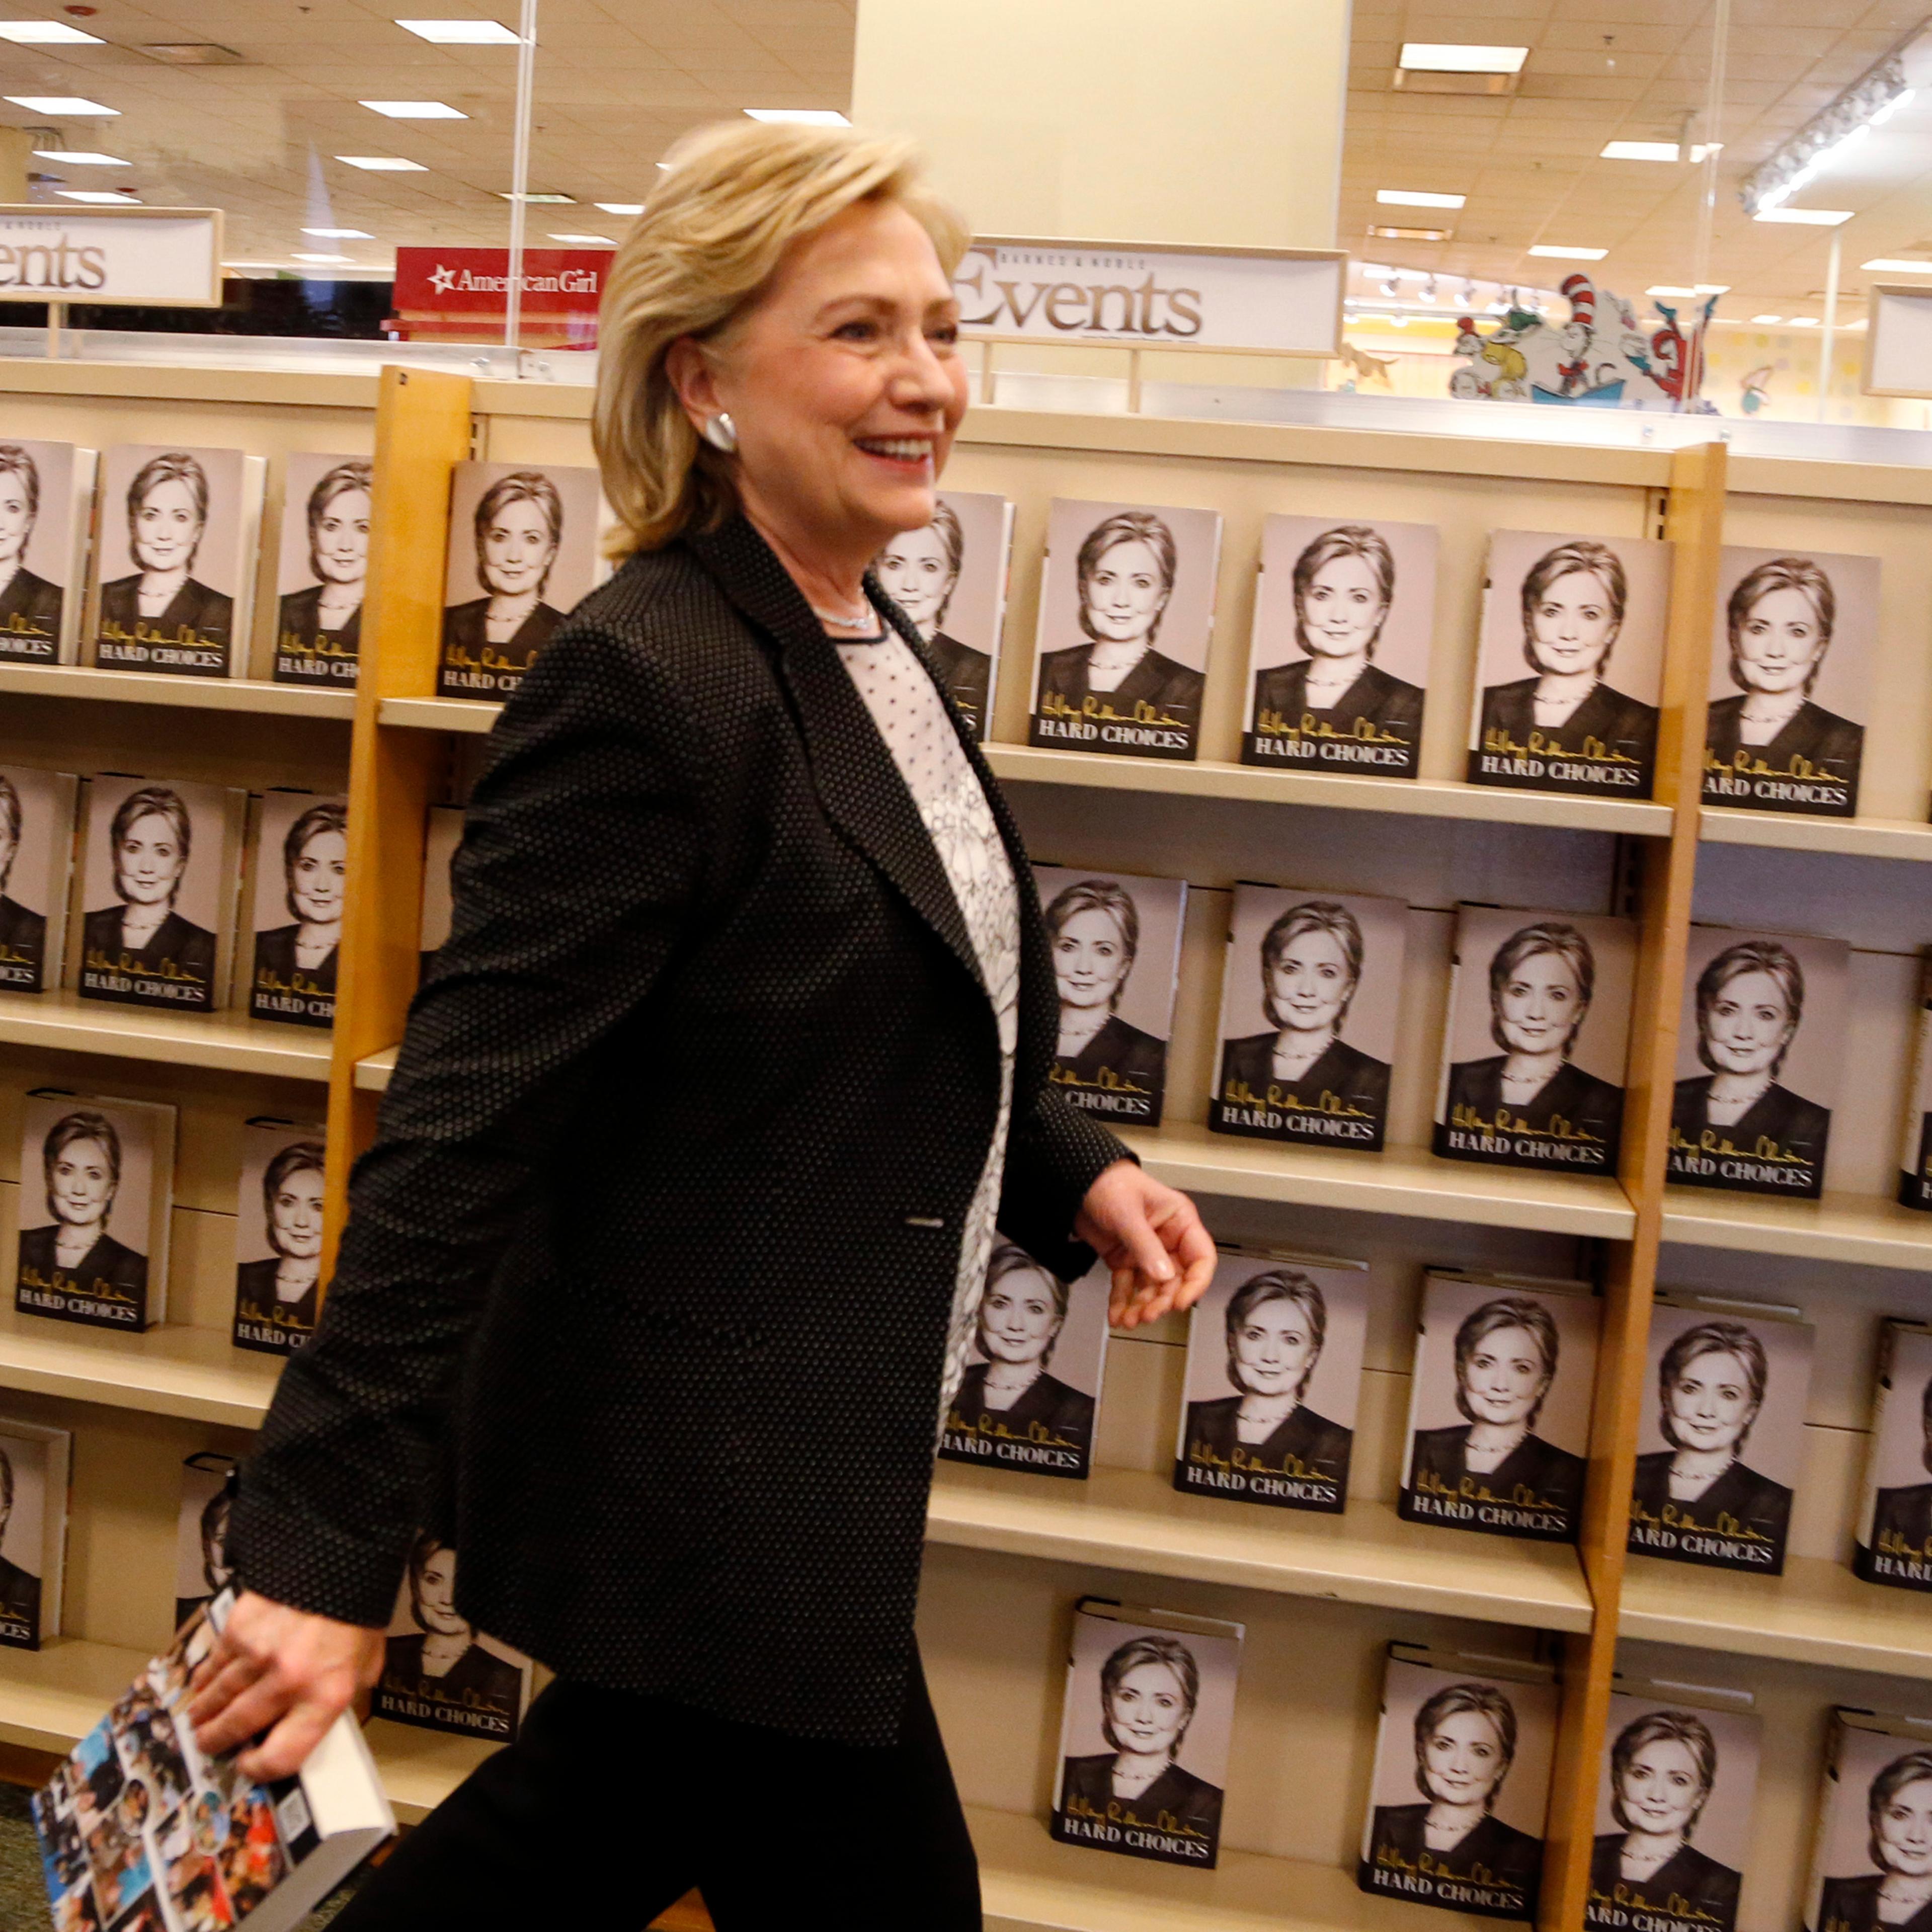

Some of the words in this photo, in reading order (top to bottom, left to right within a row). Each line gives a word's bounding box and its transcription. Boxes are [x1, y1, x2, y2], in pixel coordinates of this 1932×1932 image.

[100, 645, 149, 662] HARD
[278, 657, 329, 676] HARD
[444, 670, 495, 689] HARD
[1039, 719, 1098, 741] HARD
[1101, 725, 1189, 750] CHOICES
[1255, 737, 1317, 758] HARD
[1320, 742, 1410, 767] CHOICES
[1481, 756, 1545, 777] HARD
[1548, 762, 1641, 786] CHOICES
[1702, 776, 1751, 796] ARD
[1754, 780, 1848, 806] CHOICES
[1064, 1090, 1151, 1115] CHOICES
[1222, 1106, 1282, 1129] HARD
[1285, 1115, 1375, 1141] CHOICES
[1448, 1131, 1511, 1154] HARD
[1514, 1139, 1605, 1165] CHOICES
[1666, 1155, 1717, 1176] ARD
[1720, 1161, 1813, 1188] CHOICES
[996, 1442, 1081, 1470] CHOICES
[1187, 1466, 1246, 1490] HARD
[1250, 1477, 1337, 1503] CHOICES
[1413, 1495, 1475, 1520] HARD
[1478, 1505, 1567, 1533] CHOICES
[1631, 1526, 1677, 1549] ARD
[1681, 1535, 1773, 1564] CHOICES
[381, 1694, 431, 1718] HARD
[1064, 1818, 1121, 1842] HARD
[1124, 1830, 1210, 1859] CHOICES
[1373, 1868, 1433, 1895] HARD
[1436, 1882, 1524, 1910] CHOICES
[1586, 1905, 1628, 1926] ARD
